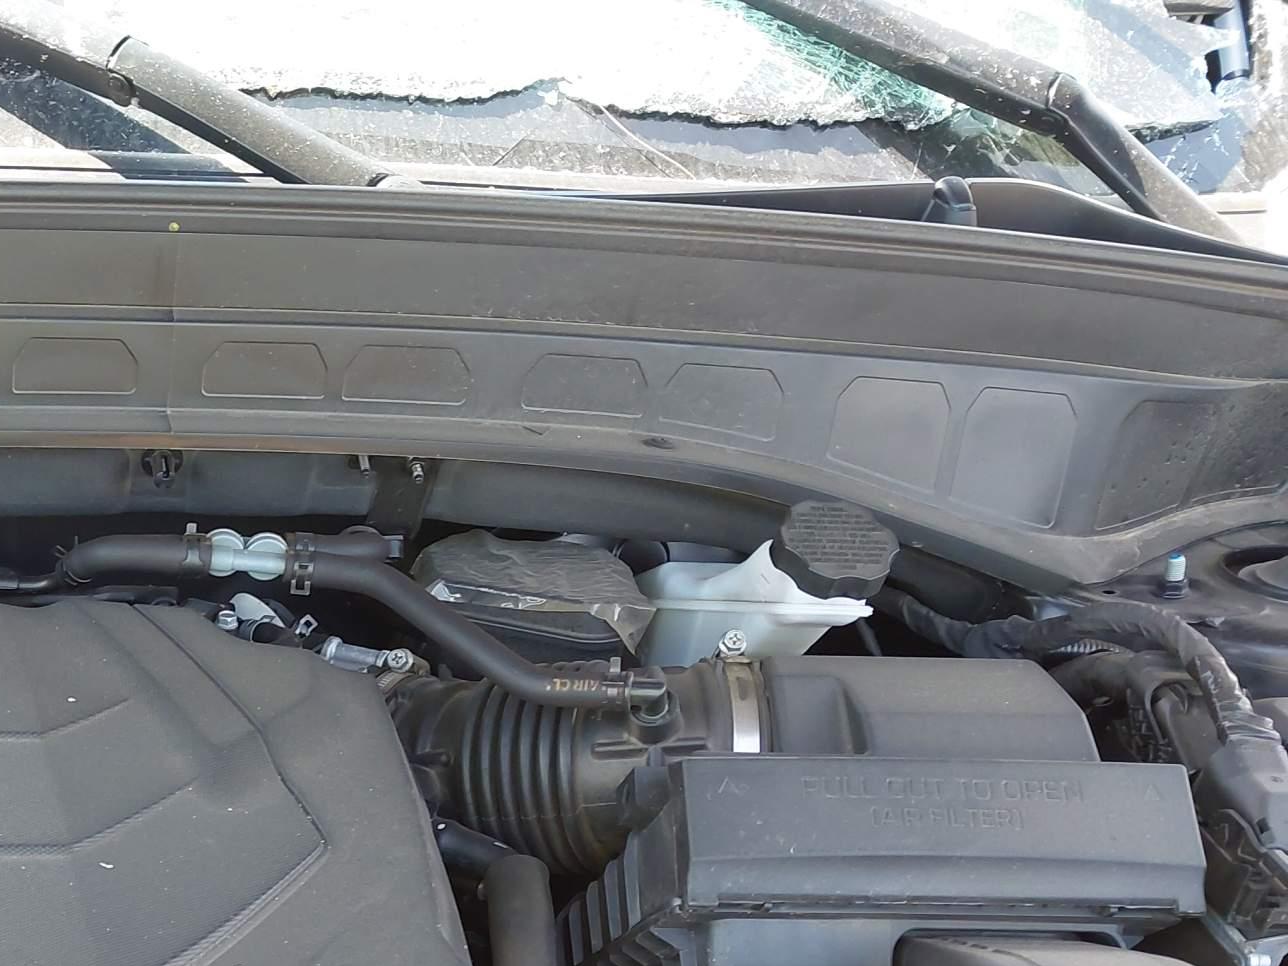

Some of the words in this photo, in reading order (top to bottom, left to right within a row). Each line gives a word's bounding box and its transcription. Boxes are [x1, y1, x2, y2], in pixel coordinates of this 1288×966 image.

[803, 776, 879, 799] PULL
[886, 777, 945, 800] OUT
[955, 778, 993, 800] TO
[1000, 779, 1083, 802] OPEN
